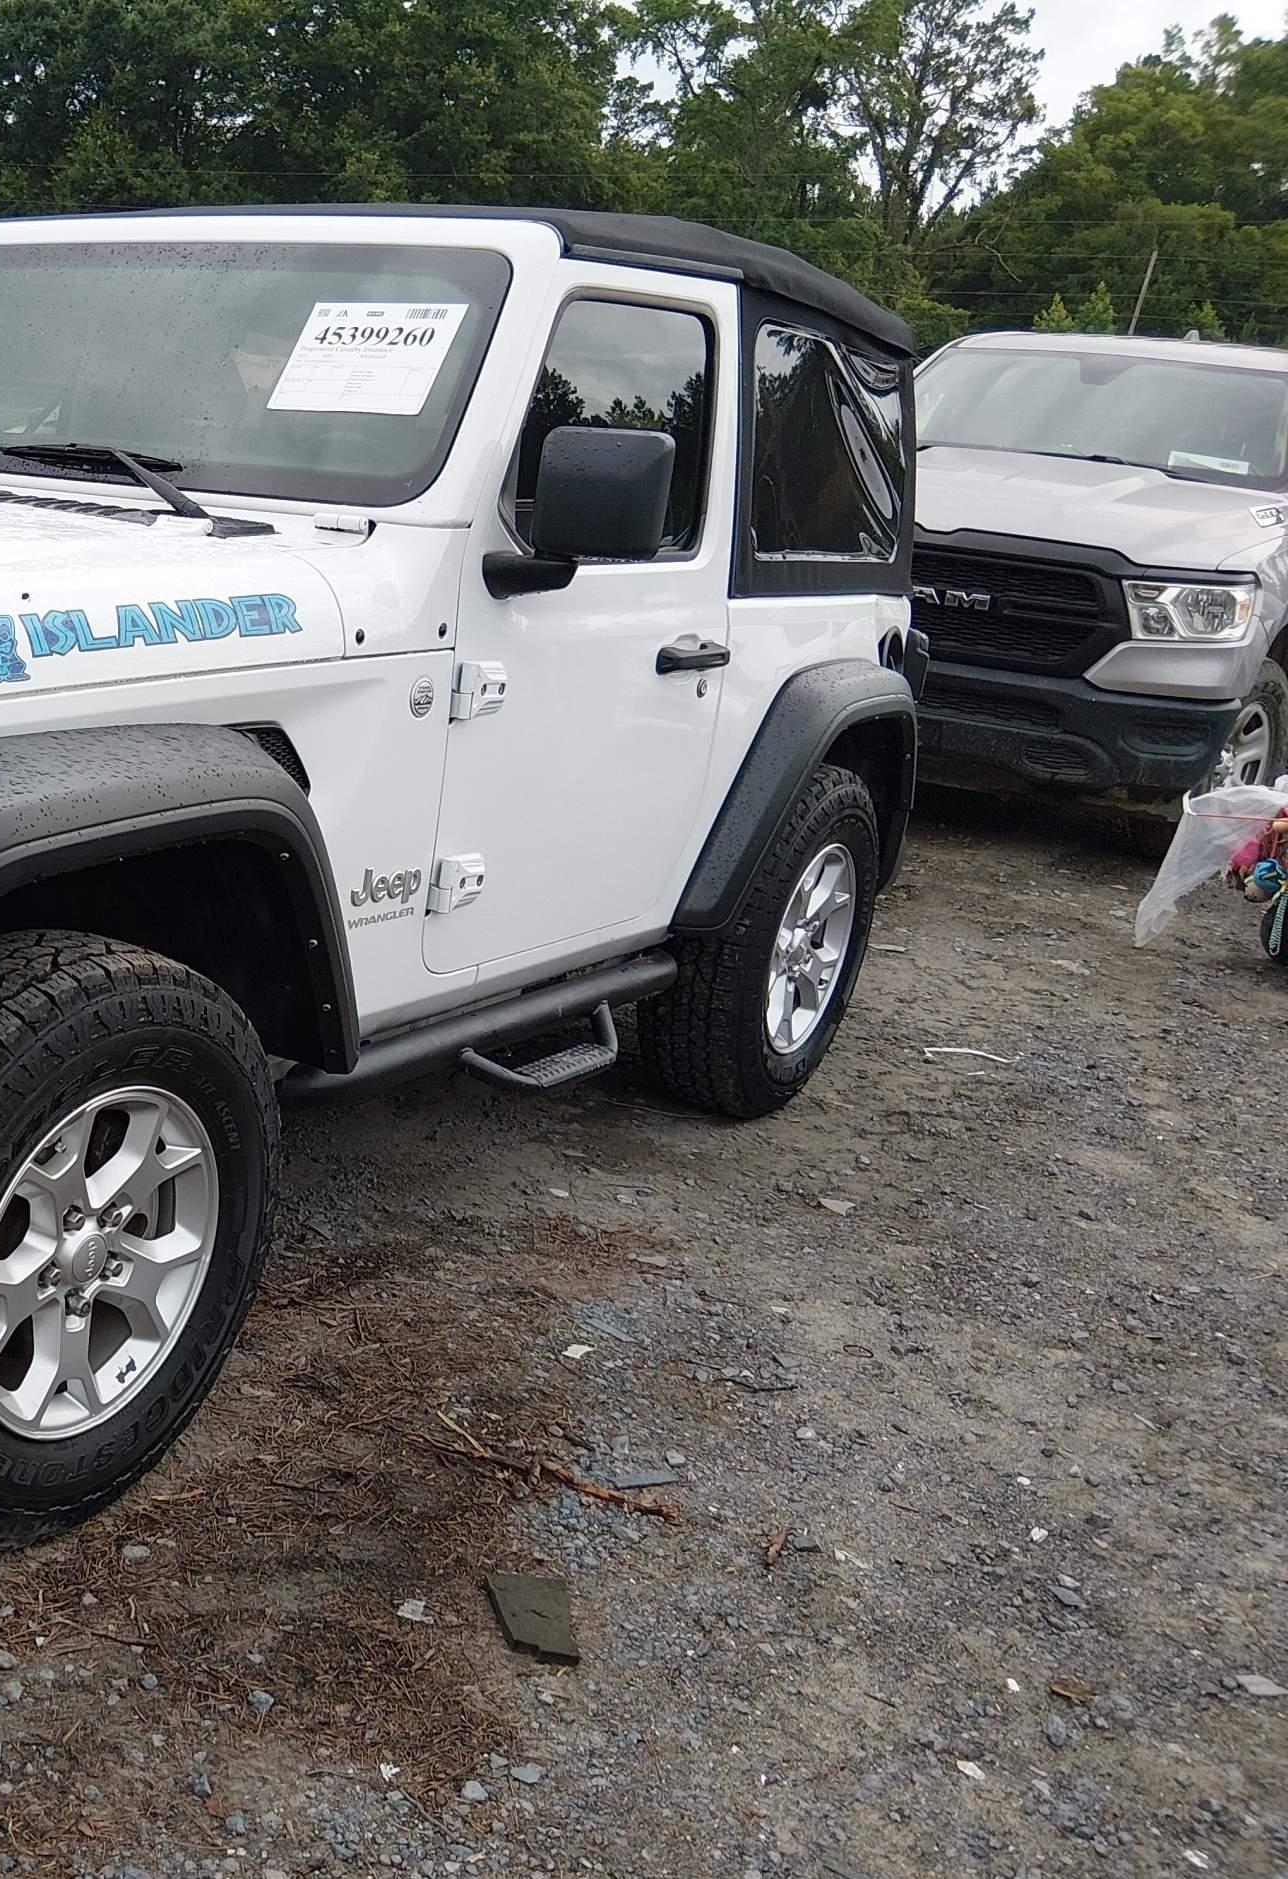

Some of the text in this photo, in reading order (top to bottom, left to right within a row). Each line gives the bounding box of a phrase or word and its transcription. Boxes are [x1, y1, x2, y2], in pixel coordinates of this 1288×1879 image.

[314, 326, 436, 347] 45399260
[912, 585, 991, 611] AM
[18, 593, 304, 659] ISLANDER
[350, 866, 422, 907] Jeep
[347, 906, 415, 931] WRANGLER
